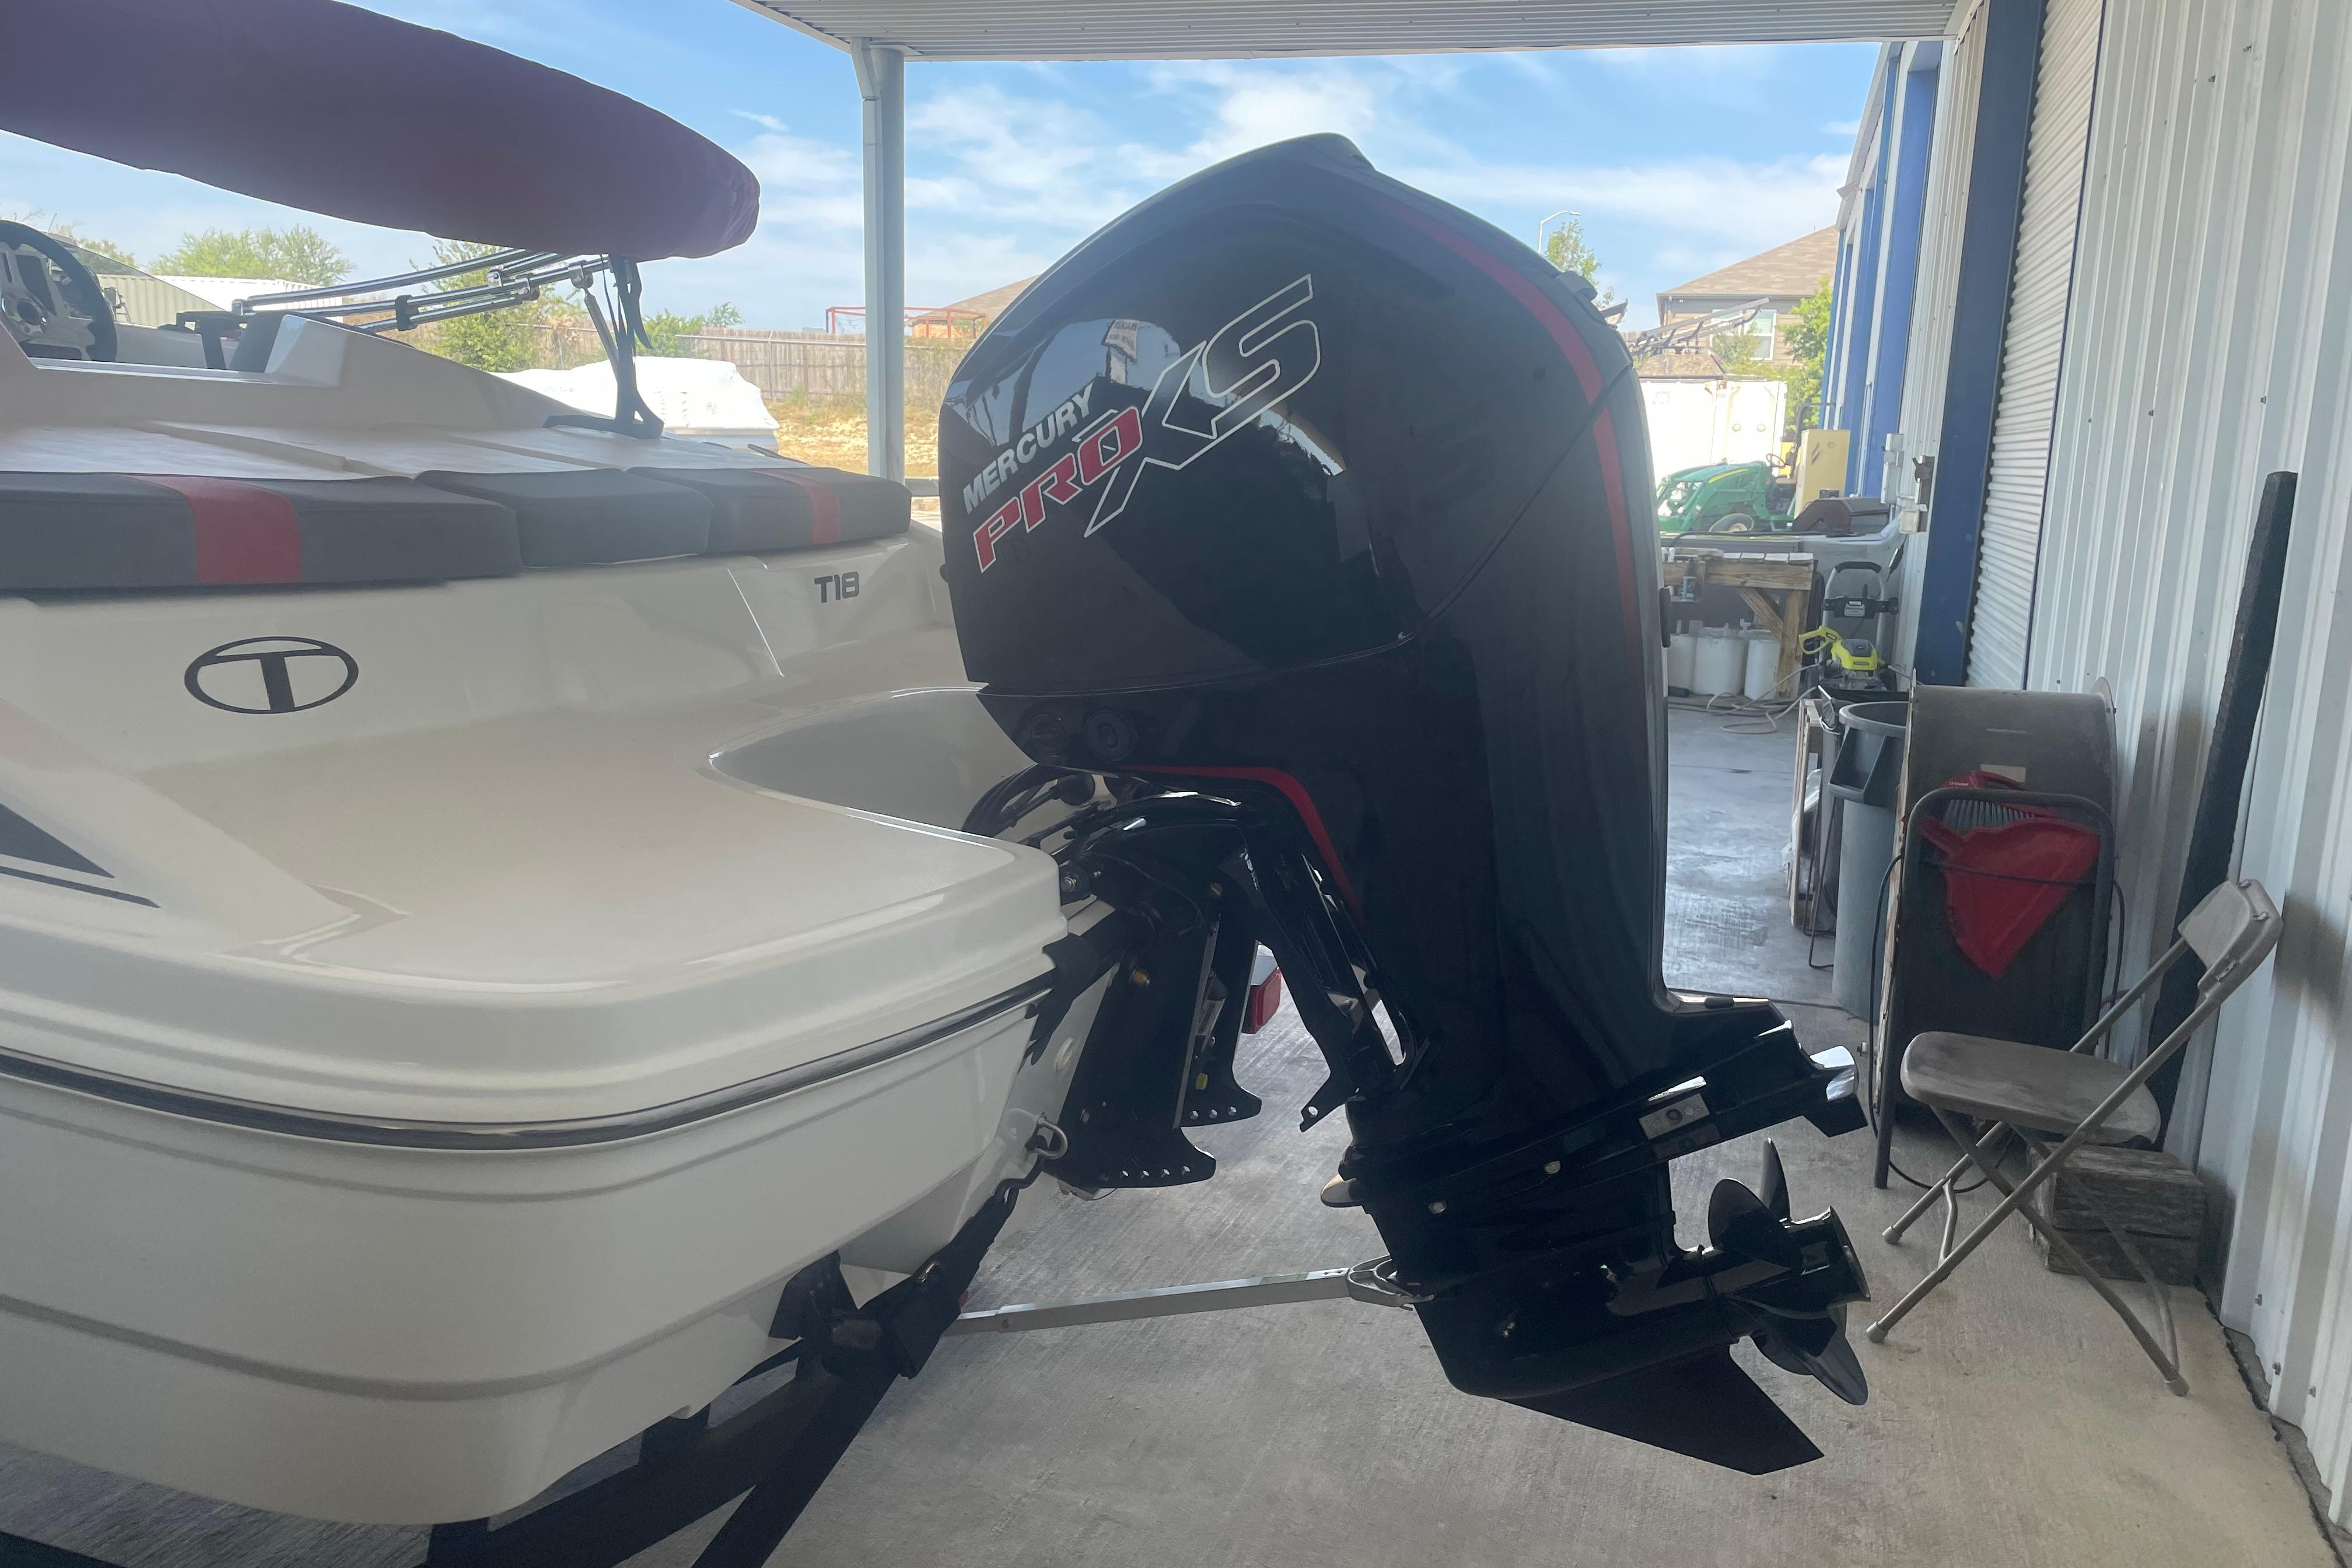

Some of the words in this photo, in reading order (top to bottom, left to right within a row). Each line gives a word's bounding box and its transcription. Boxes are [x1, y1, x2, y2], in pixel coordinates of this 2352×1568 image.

[963, 381, 1094, 514] MERCURY
[972, 406, 1143, 573] PRO
[1083, 274, 1320, 538] XS
[814, 571, 859, 603] T18
